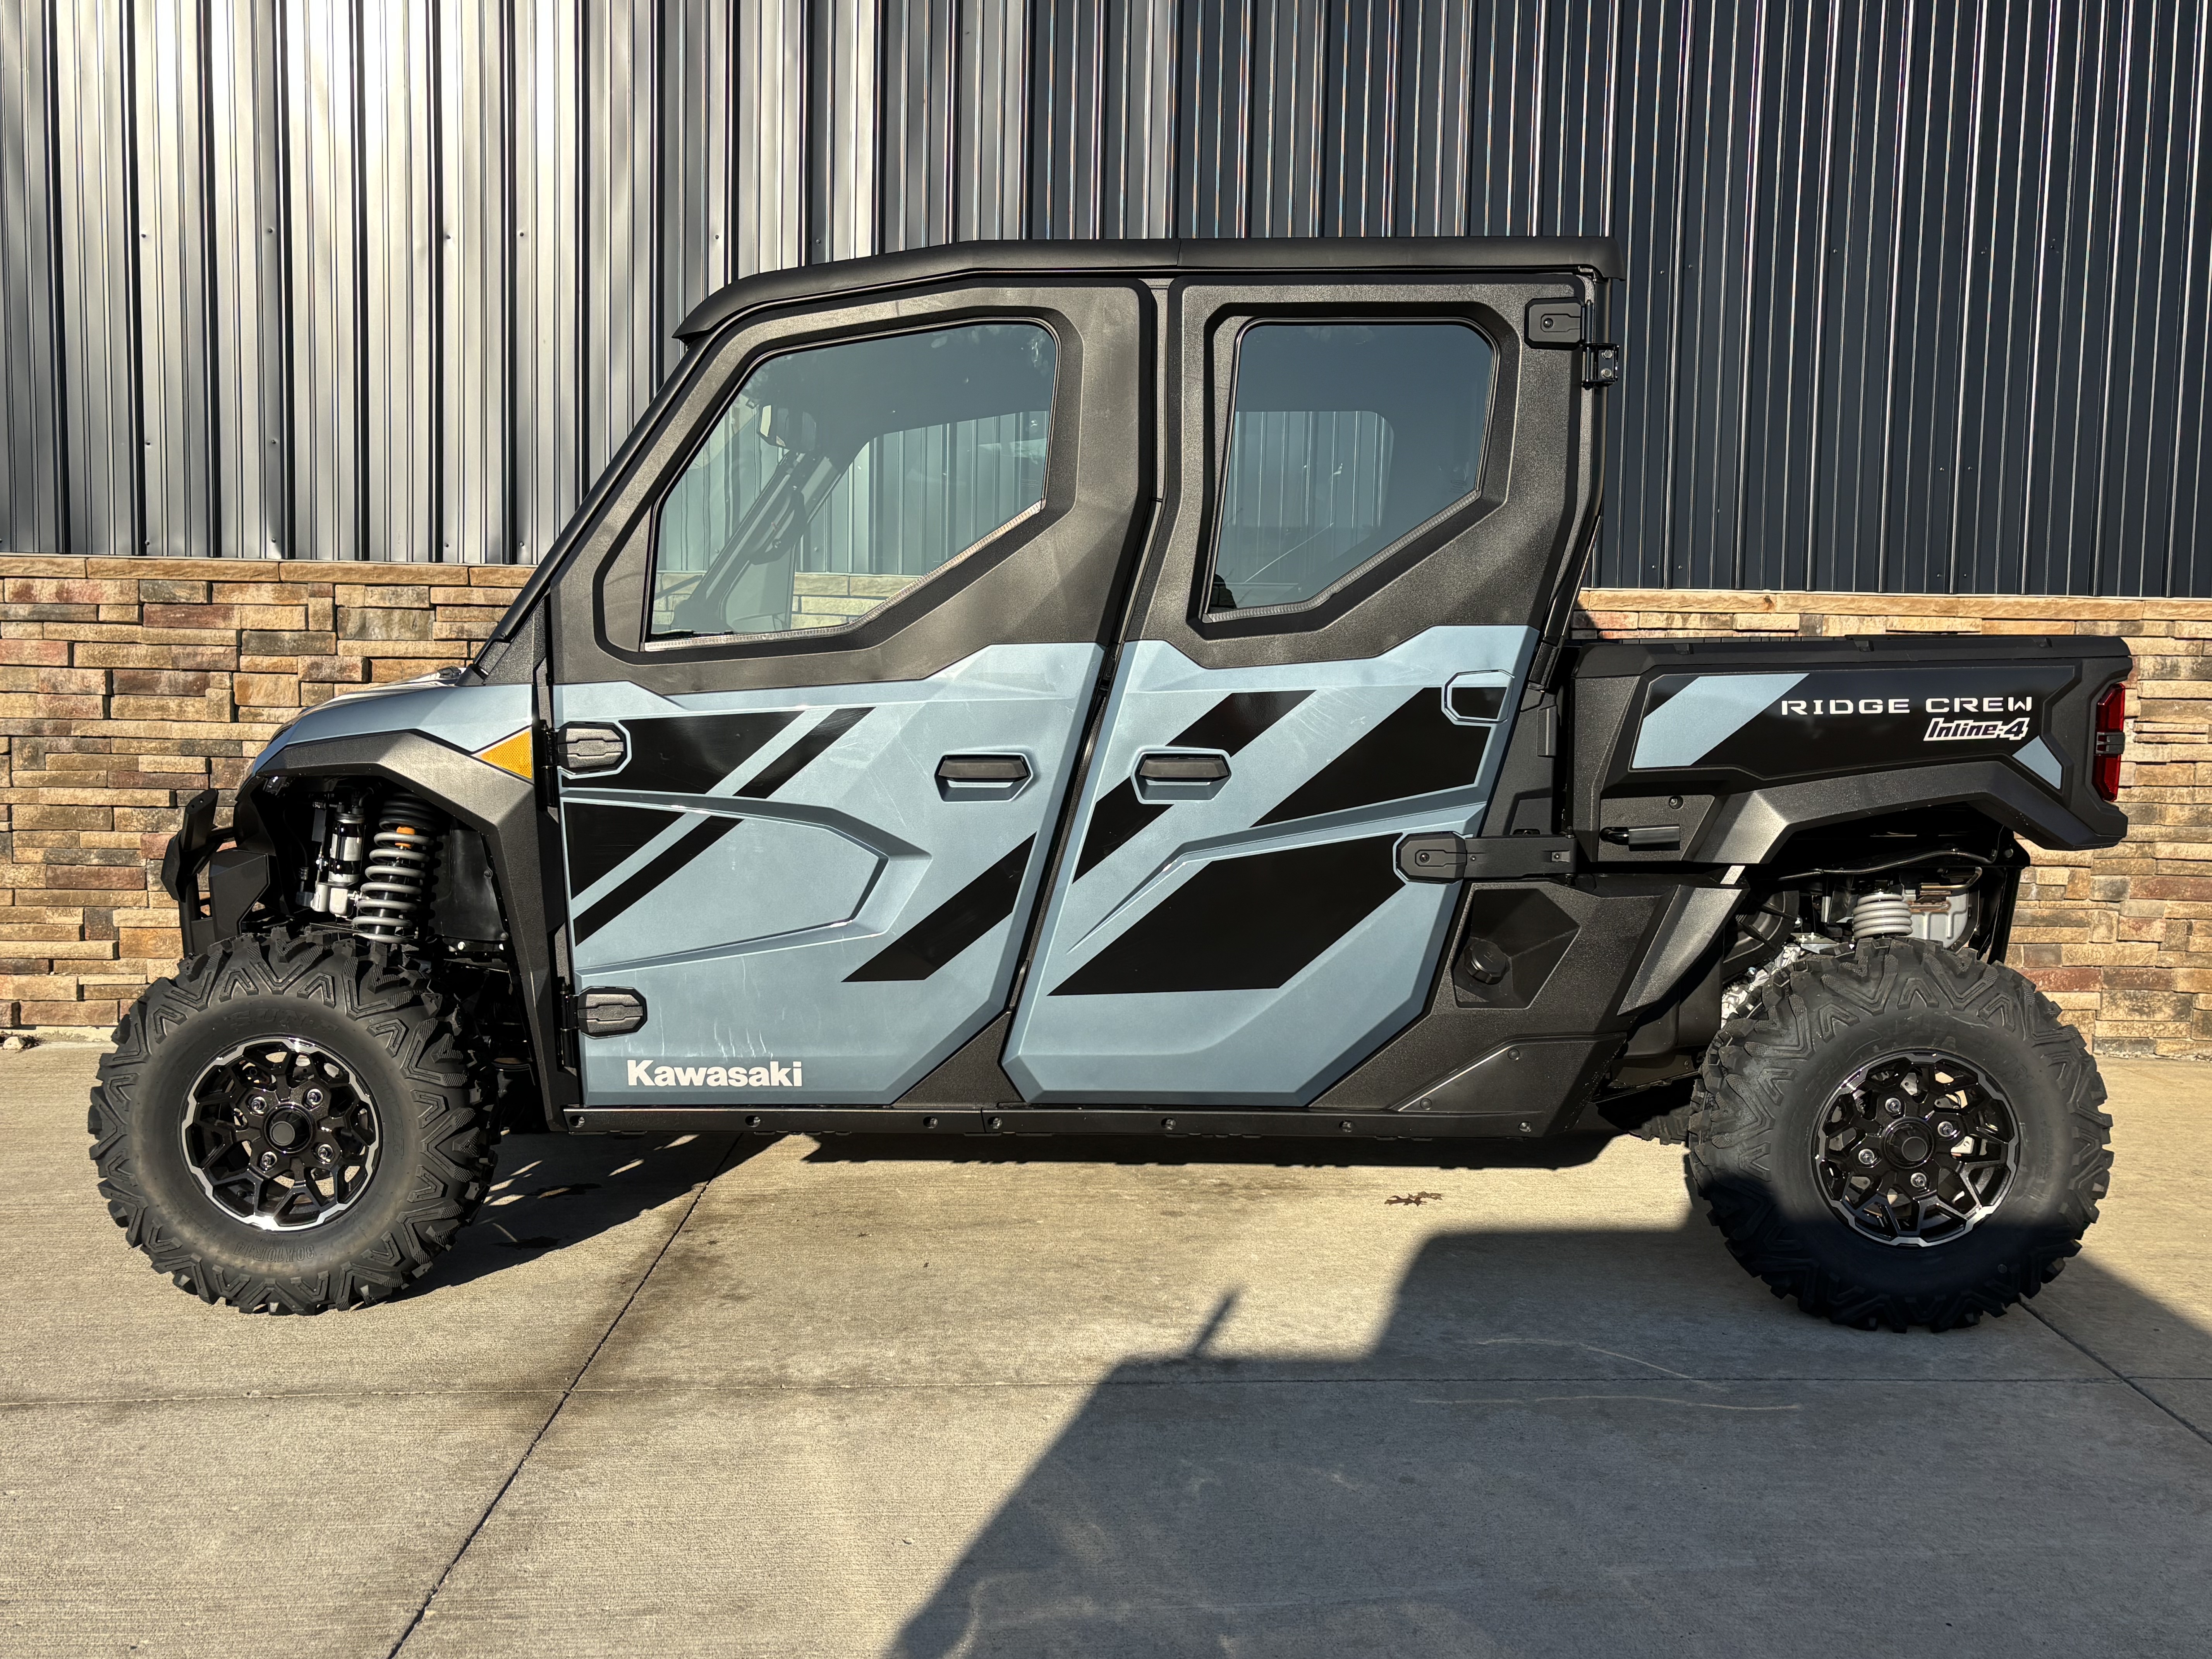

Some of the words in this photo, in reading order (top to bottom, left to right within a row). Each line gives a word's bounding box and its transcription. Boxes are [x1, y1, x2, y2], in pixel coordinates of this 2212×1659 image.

[1781, 698, 1910, 715] RIDGE
[1925, 697, 2032, 713] CREW
[1923, 718, 2030, 741] Inline-4
[627, 1060, 802, 1087] Kawasaki
